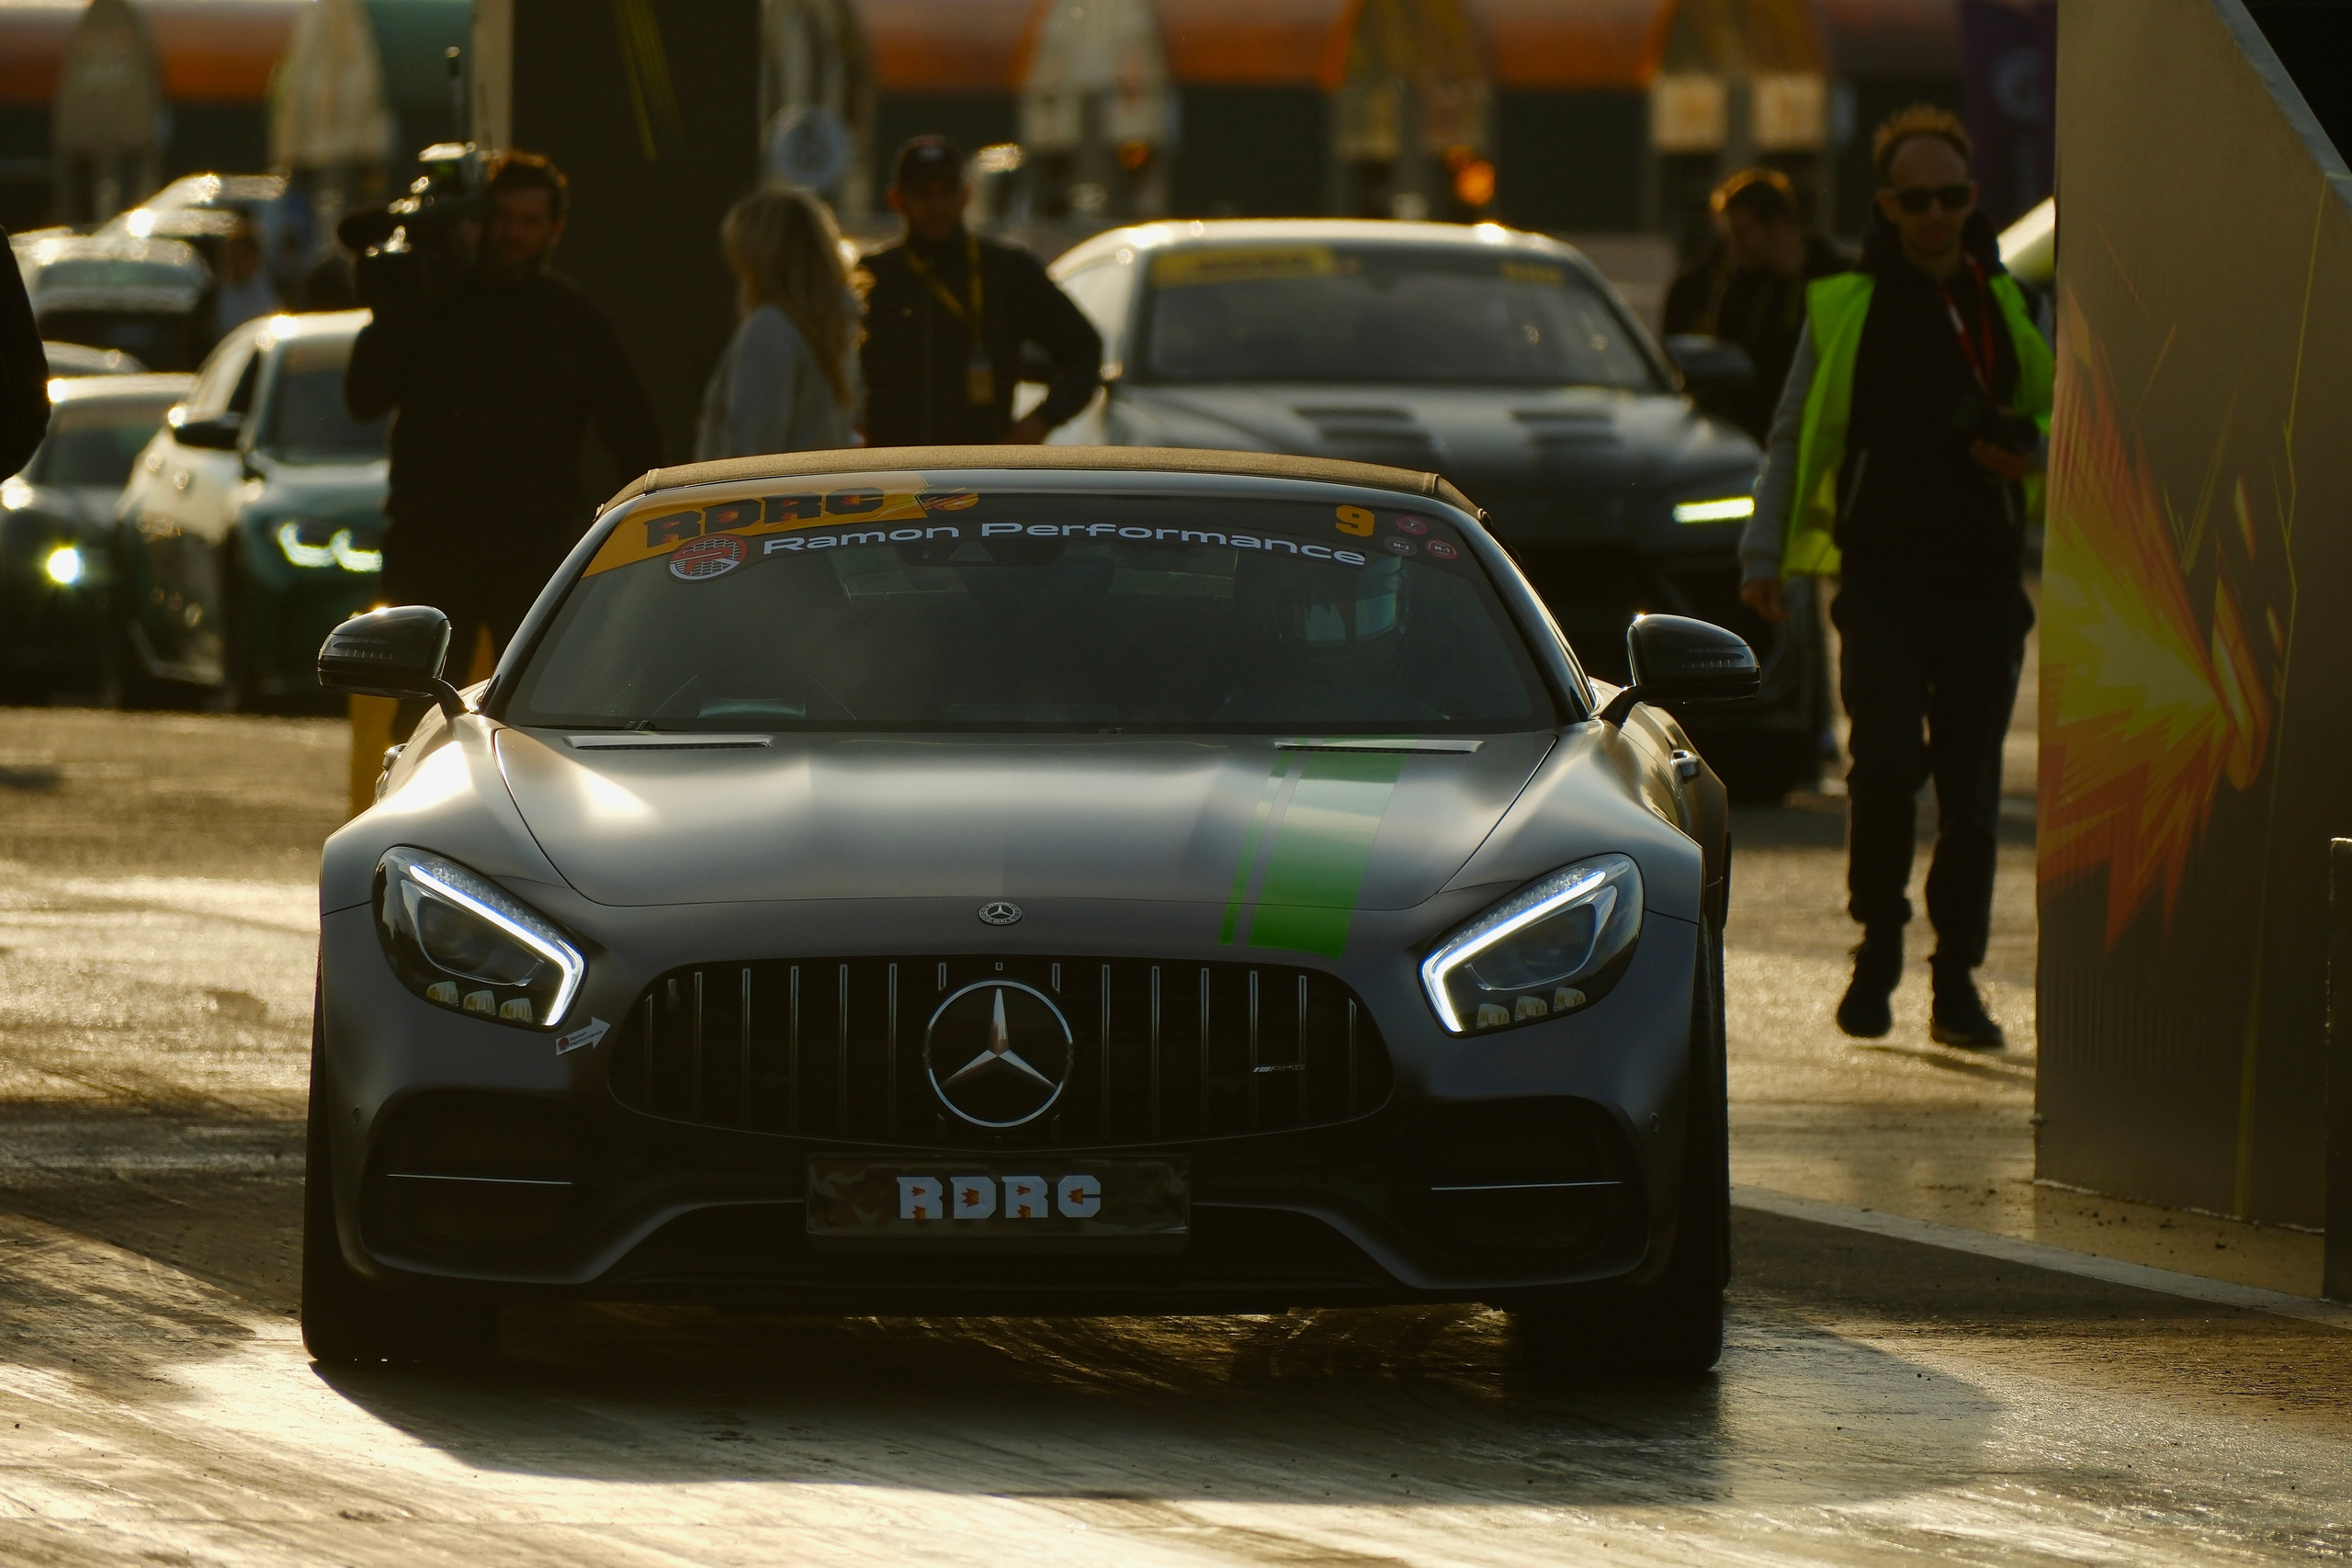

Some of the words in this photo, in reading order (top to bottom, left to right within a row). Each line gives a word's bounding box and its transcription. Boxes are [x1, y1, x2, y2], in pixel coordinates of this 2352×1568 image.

[643, 486, 885, 548] RDRC
[1335, 504, 1375, 537] 9
[763, 524, 960, 556] Ramon
[981, 522, 1366, 567] Performance
[1393, 542, 1410, 551] M-2
[1434, 545, 1450, 553] M-1
[896, 1174, 1102, 1220] RDRC
